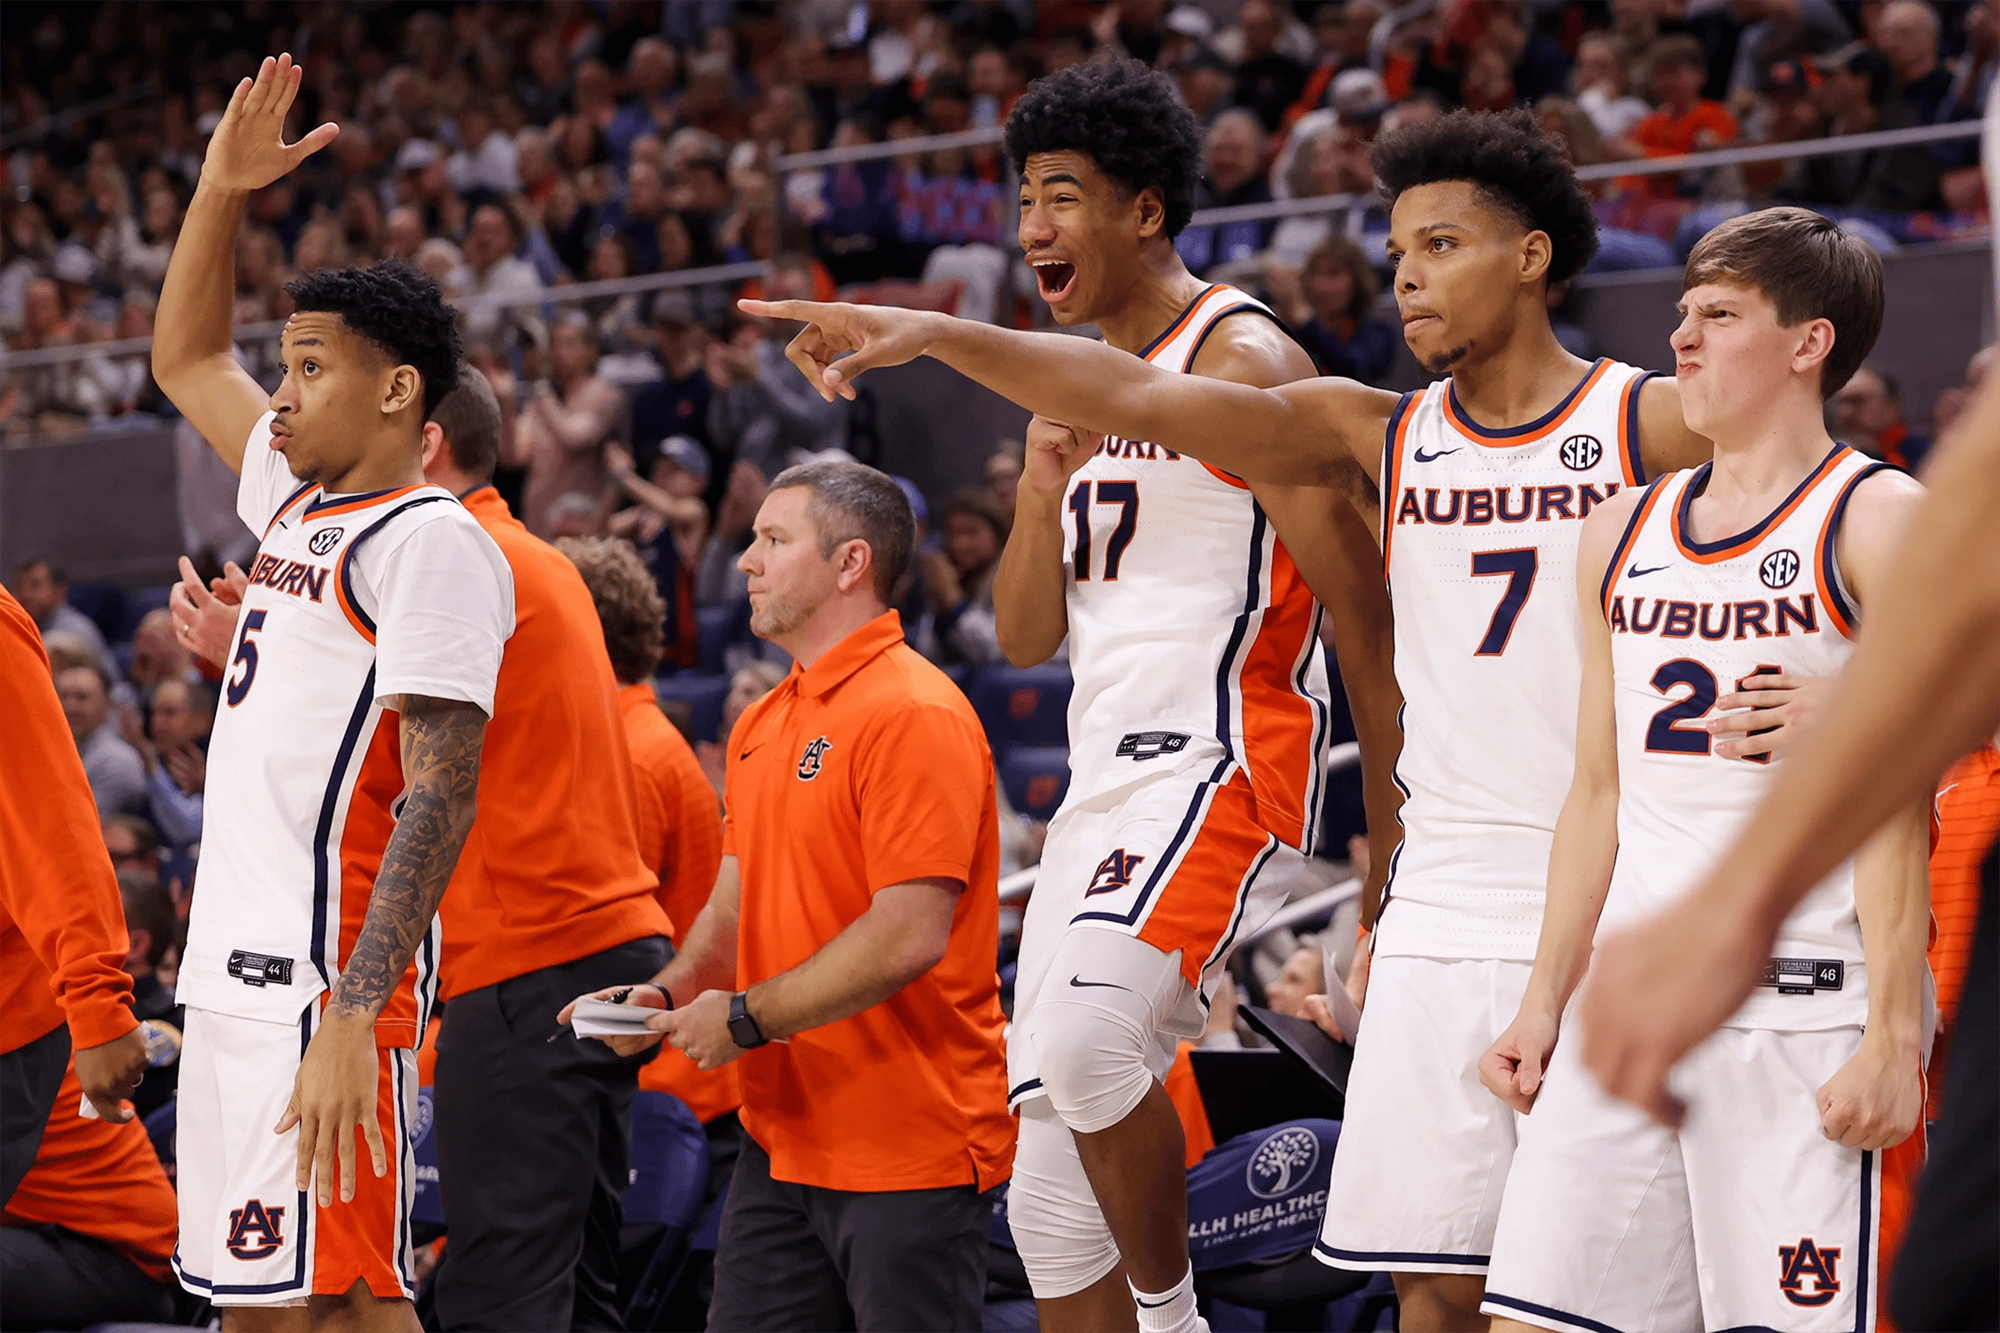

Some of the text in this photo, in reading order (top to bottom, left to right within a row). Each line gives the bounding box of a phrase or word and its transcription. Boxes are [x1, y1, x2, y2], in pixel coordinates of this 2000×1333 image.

[1564, 437, 1599, 468] SEC
[1397, 483, 1620, 526] AUBURN
[310, 528, 343, 554] SEC
[1069, 480, 1140, 582] 17
[1763, 551, 1797, 587] SEC
[1470, 547, 1539, 657] 7
[1611, 593, 1820, 641] AUBURN
[227, 609, 268, 709] 5
[1166, 737, 1181, 748] 46
[1084, 847, 1147, 900] AU
[268, 963, 280, 976] 44
[1820, 968, 1837, 982] 46
[226, 1198, 286, 1262] AU
[1233, 1189, 1329, 1230] HEALTHC
[1777, 1236, 1842, 1308] AU
